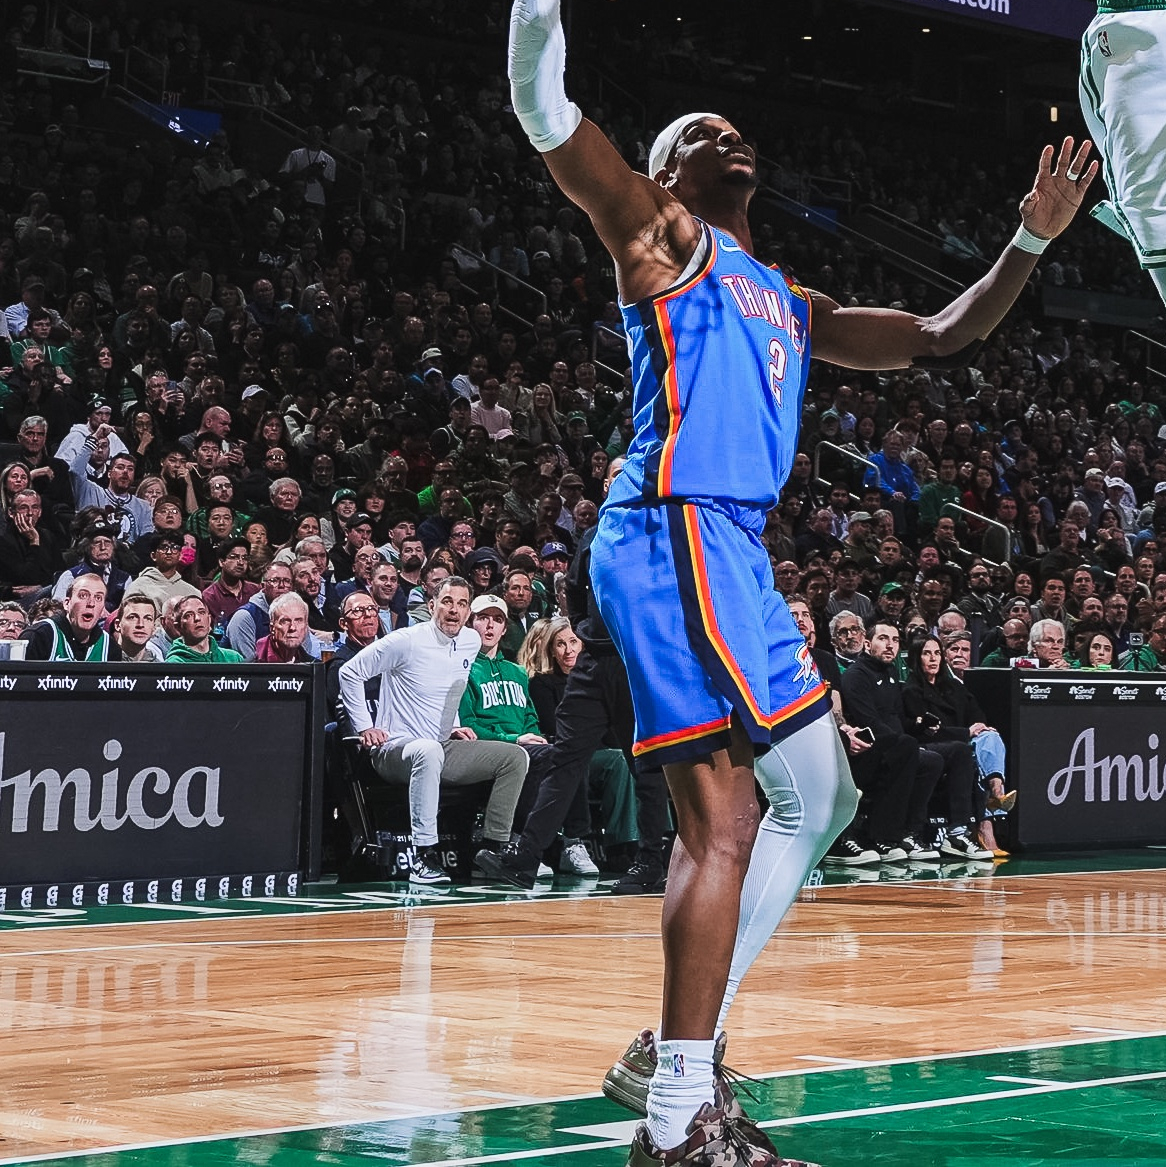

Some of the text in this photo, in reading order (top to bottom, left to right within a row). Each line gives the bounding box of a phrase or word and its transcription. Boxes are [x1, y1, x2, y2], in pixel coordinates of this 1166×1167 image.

[768, 337, 788, 410] 2
[37, 675, 78, 691] xfinity
[97, 675, 137, 691] xfinity
[156, 676, 194, 691] xfinity
[212, 676, 249, 692] xfinity
[267, 677, 304, 692] xfinity
[480, 680, 527, 710] BOSTON
[0, 732, 225, 832] mica
